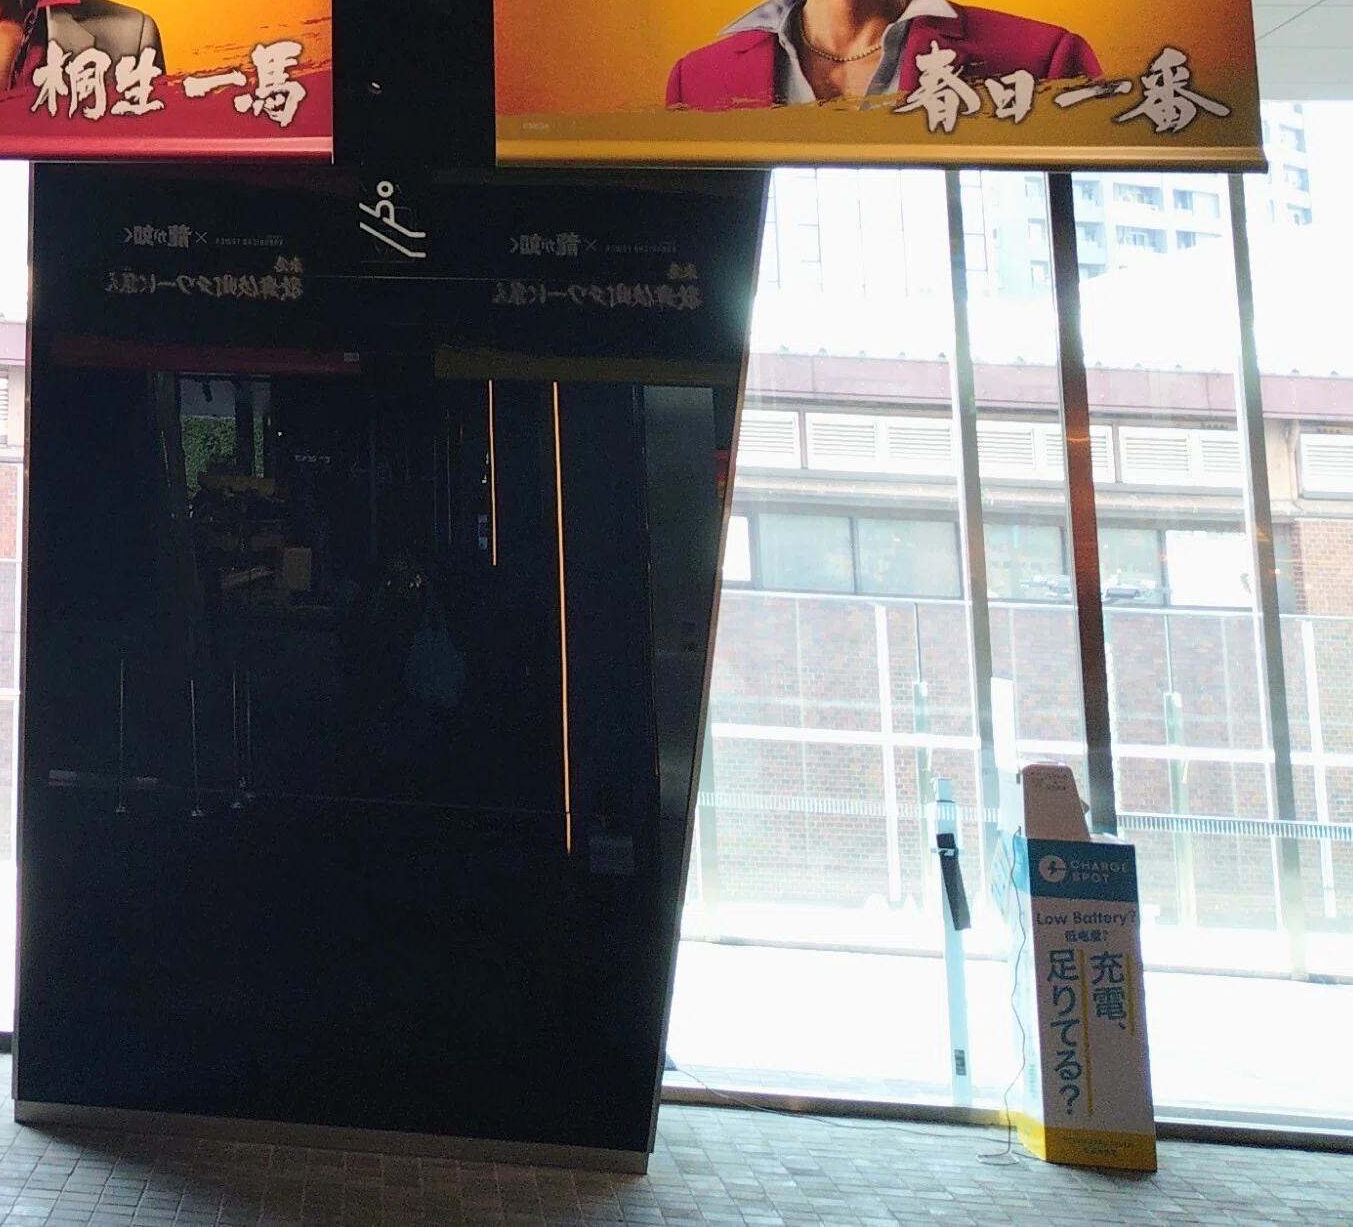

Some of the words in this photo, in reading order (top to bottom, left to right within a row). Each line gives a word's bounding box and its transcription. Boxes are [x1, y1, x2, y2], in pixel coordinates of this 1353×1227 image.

[1070, 860, 1129, 874] CHARGE
[1037, 912, 1067, 926] Low
[1073, 910, 1136, 926] Battery?
[1047, 948, 1083, 1115] 足りてる?
